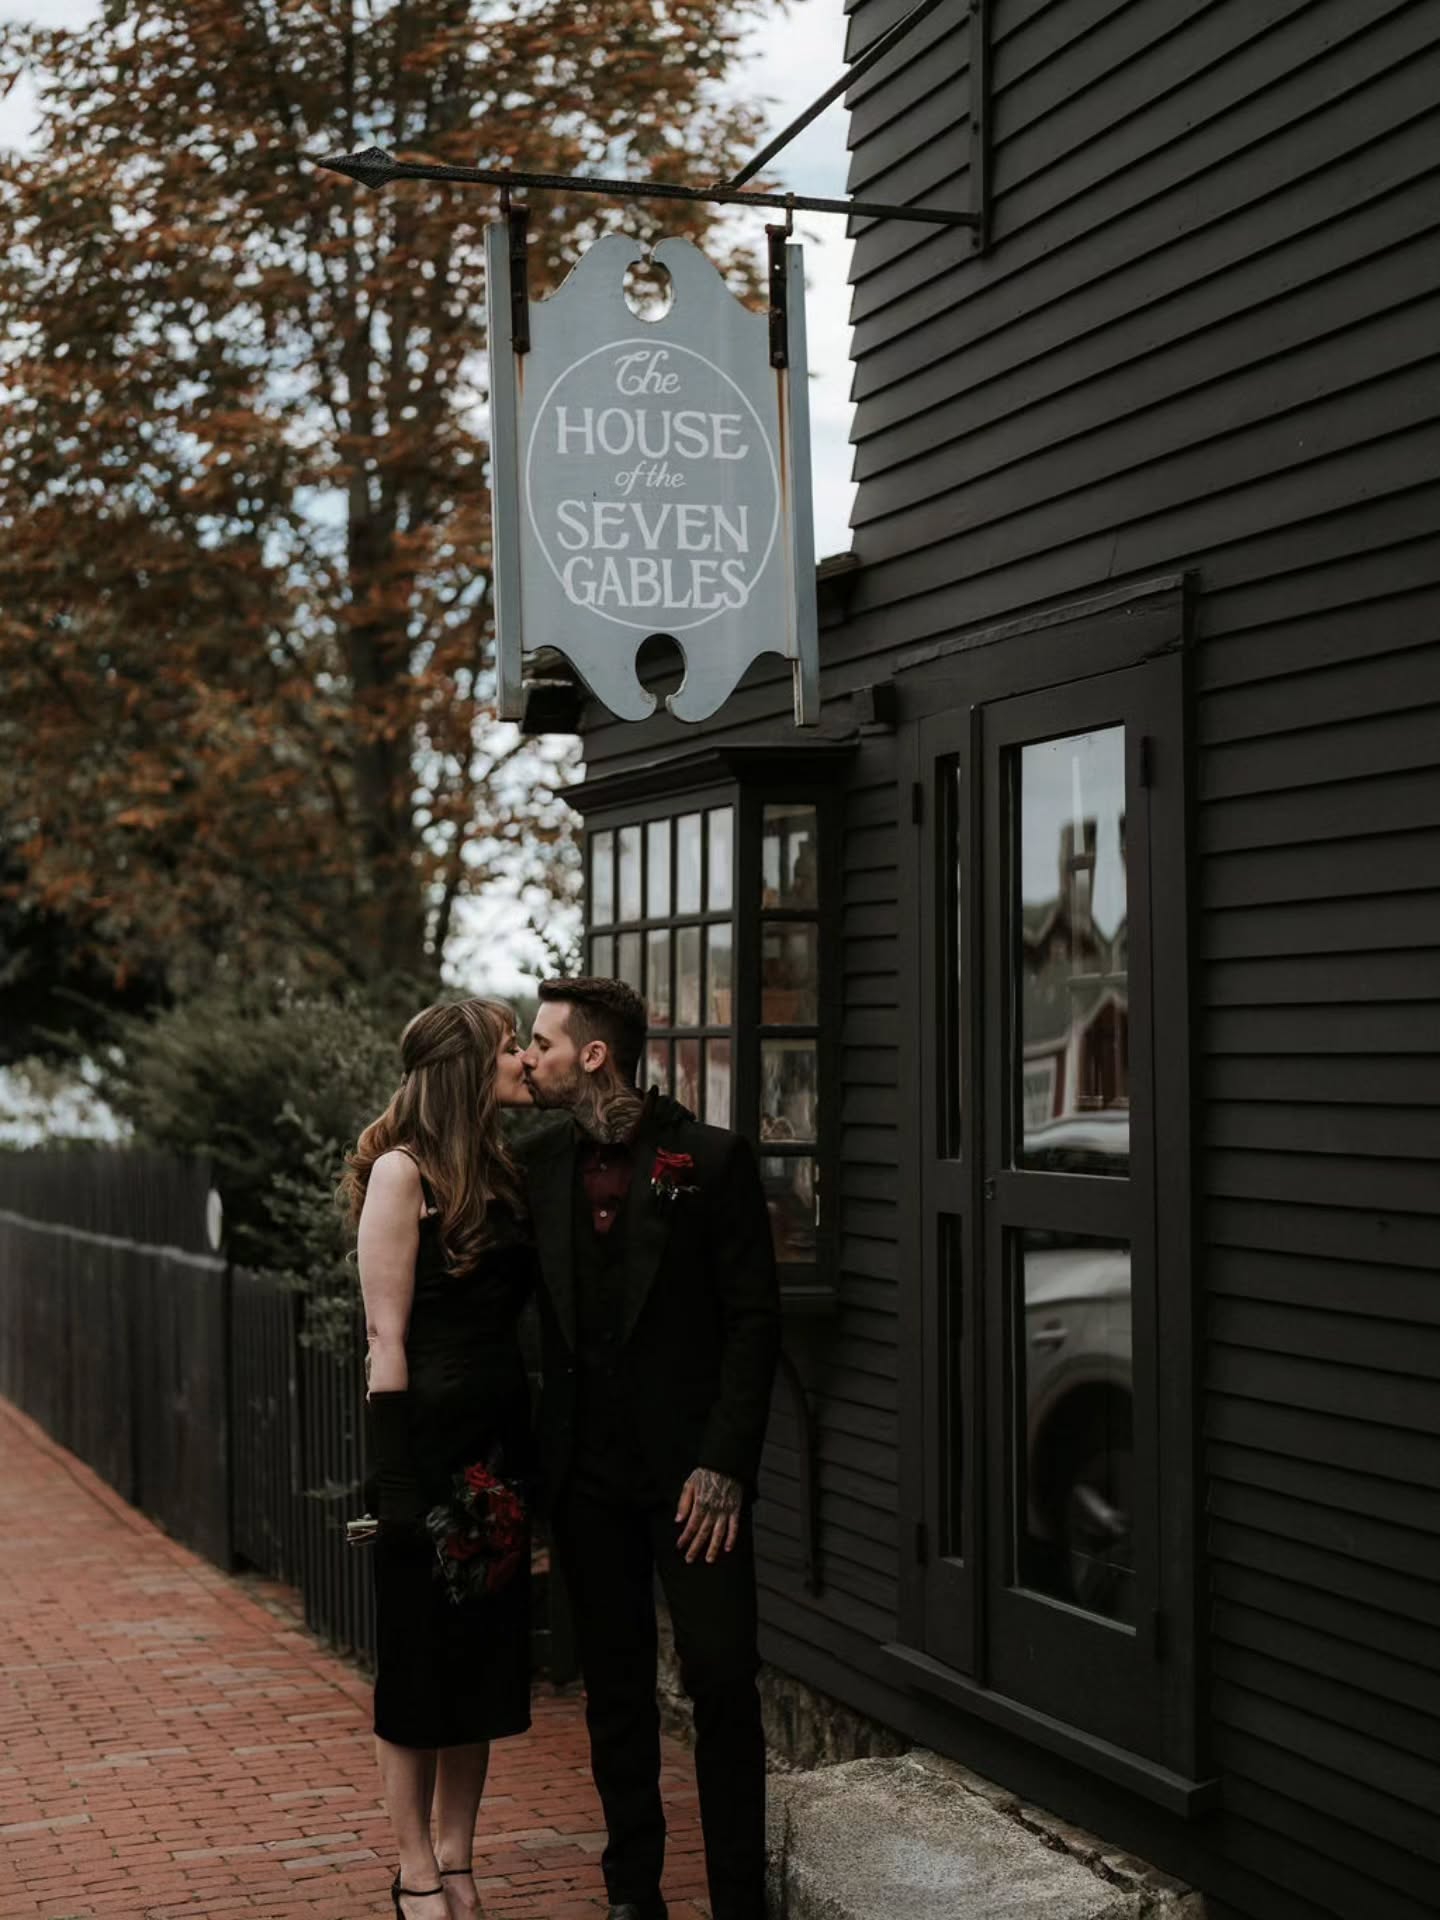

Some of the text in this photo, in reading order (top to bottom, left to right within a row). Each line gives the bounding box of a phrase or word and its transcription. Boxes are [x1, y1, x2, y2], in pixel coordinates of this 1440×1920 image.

[614, 350, 681, 395] The
[555, 406, 749, 460] HOUSE
[614, 460, 687, 496] of the
[556, 499, 749, 553] SEVEN
[562, 555, 751, 609] GABLES
